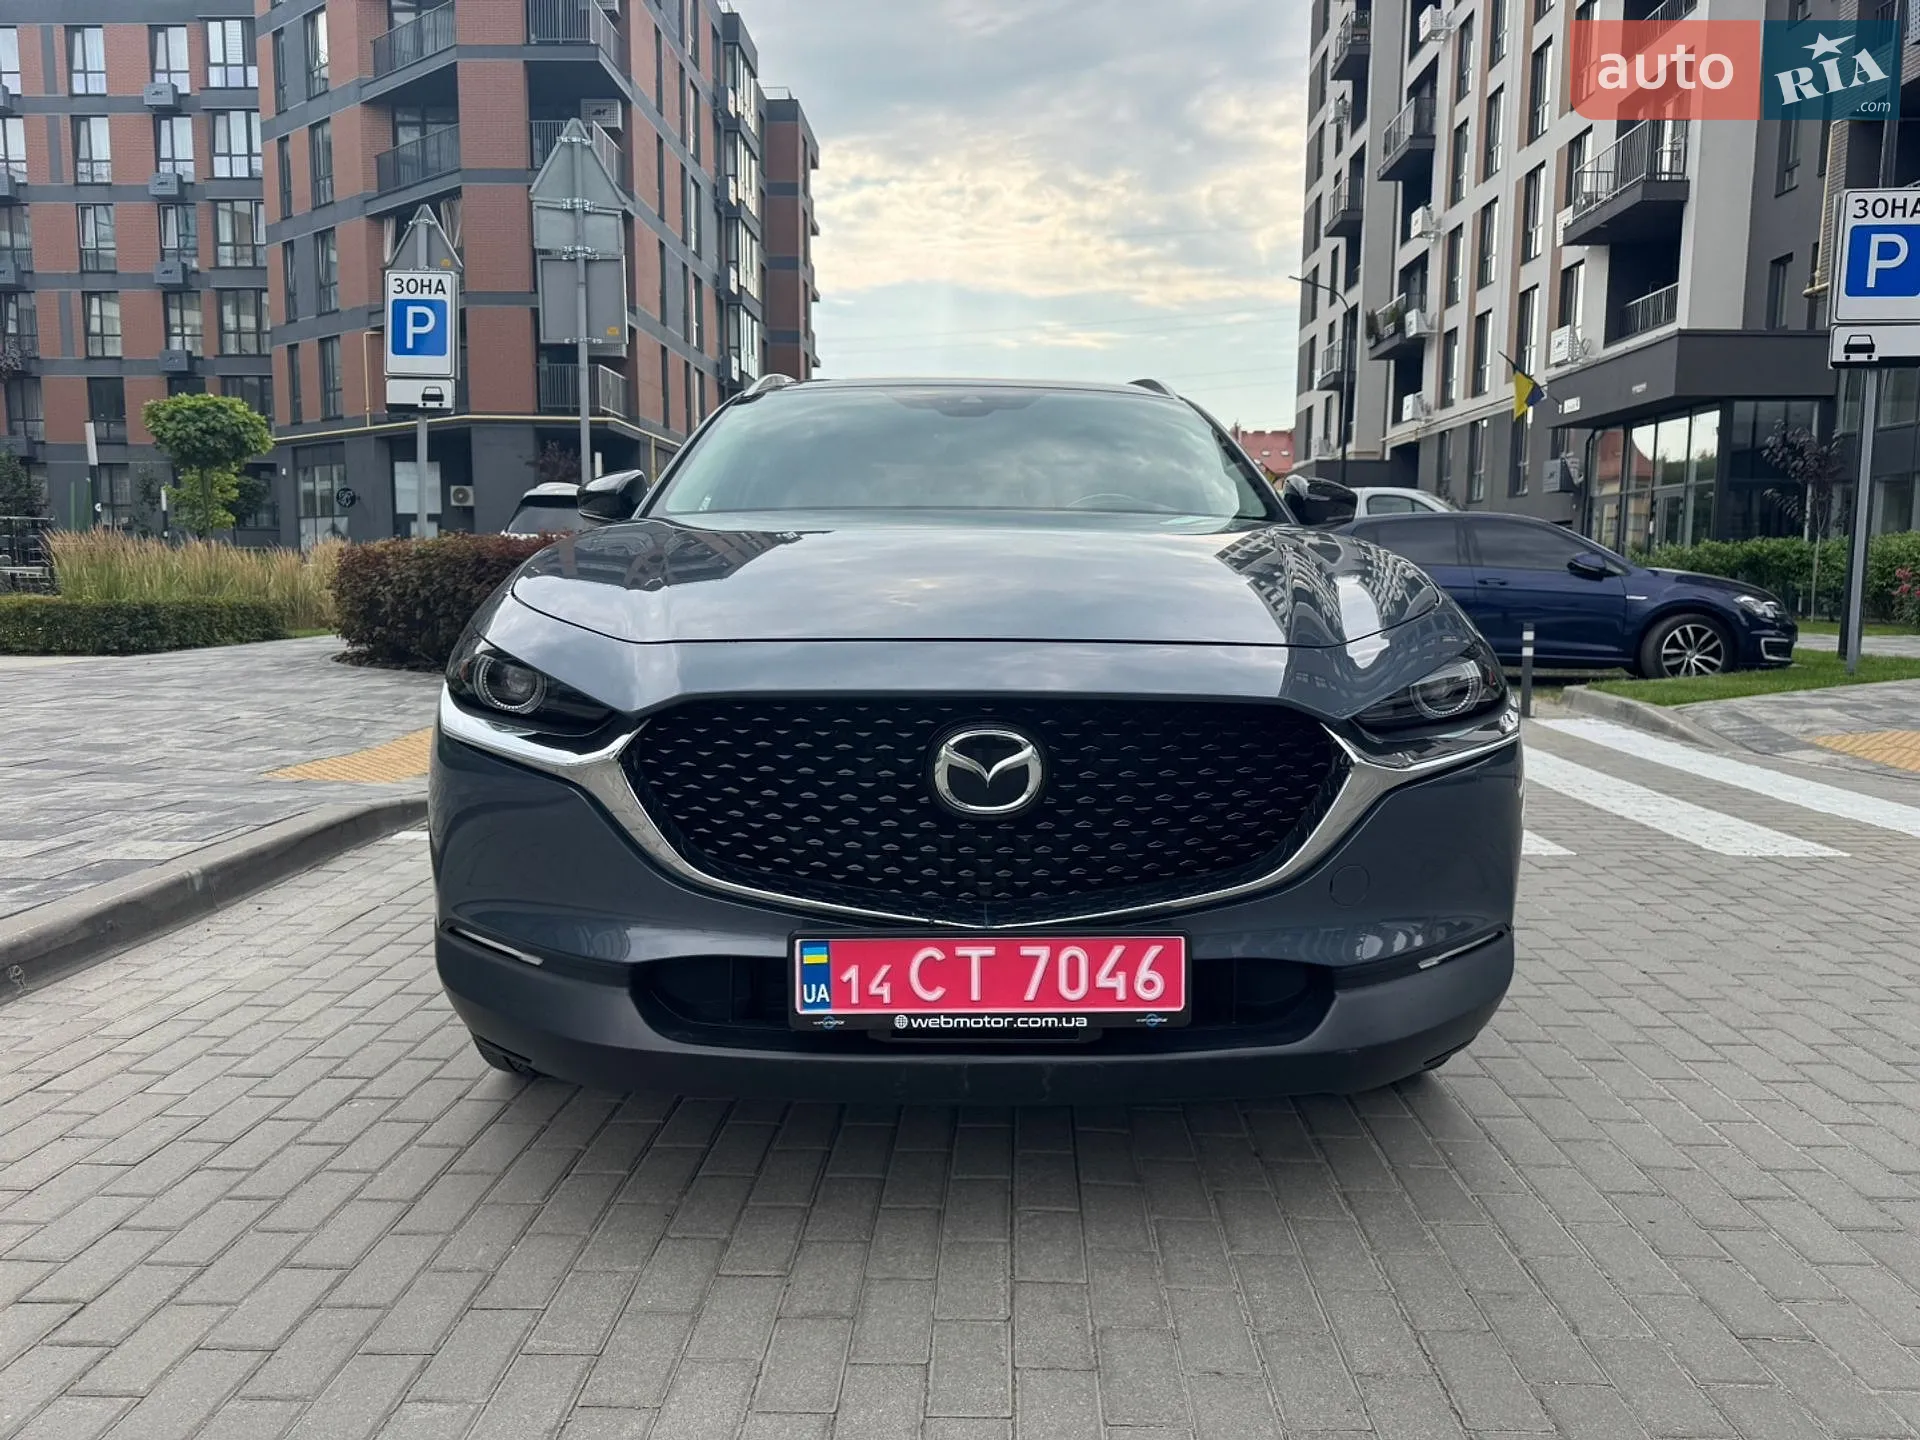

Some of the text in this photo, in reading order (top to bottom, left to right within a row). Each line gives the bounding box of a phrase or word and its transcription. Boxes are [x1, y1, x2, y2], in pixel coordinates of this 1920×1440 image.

[1866, 233, 1909, 288] P
[393, 278, 446, 295] ЗОНА
[406, 305, 436, 349] P
[840, 964, 892, 1005] 14
[1019, 945, 1166, 1002] 7046
[803, 983, 830, 1003] UA
[911, 1014, 1088, 1029] webmotor.com.ua
